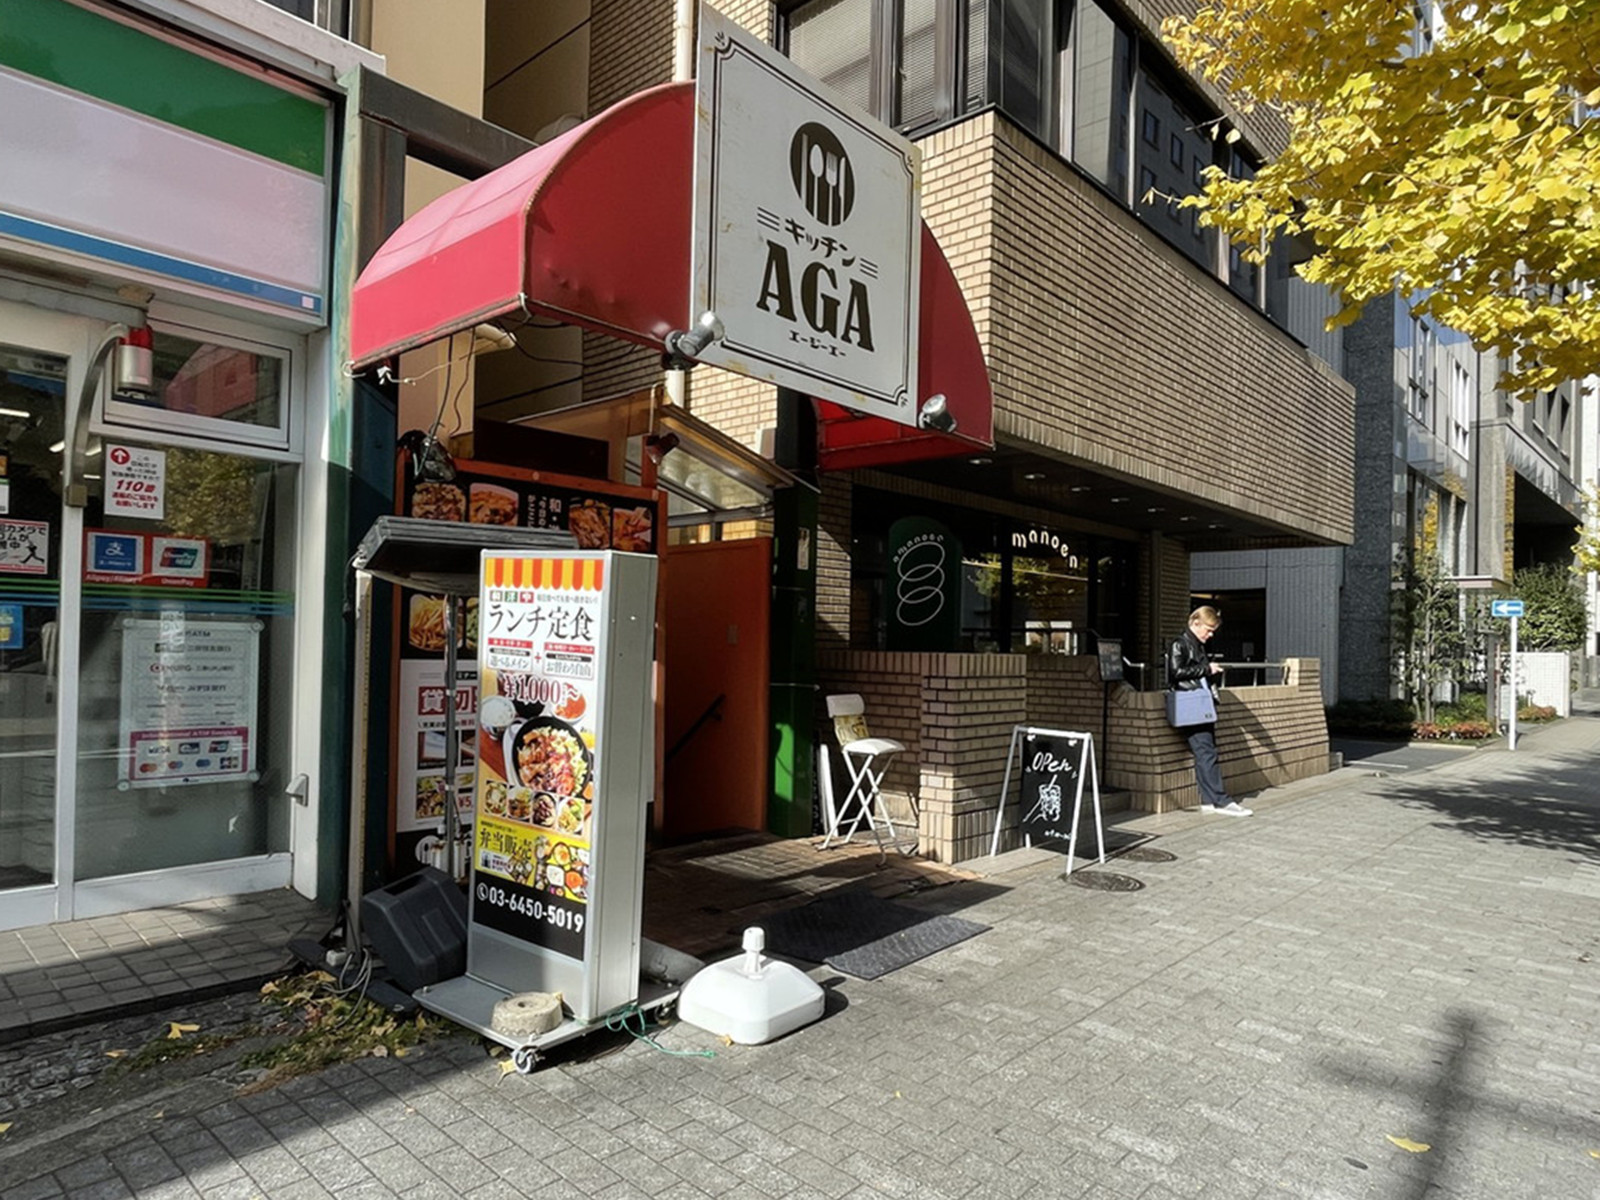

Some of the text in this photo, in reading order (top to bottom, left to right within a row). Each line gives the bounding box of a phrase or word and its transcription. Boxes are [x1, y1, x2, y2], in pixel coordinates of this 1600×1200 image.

[784, 217, 857, 267] キッチン
[756, 239, 875, 353] AGA
[117, 479, 156, 493] 110番
[1011, 529, 1079, 569] manoen
[488, 603, 595, 641] ランチ定食
[480, 827, 533, 860] 弁当販売
[489, 886, 584, 934] 03-6450-5019
